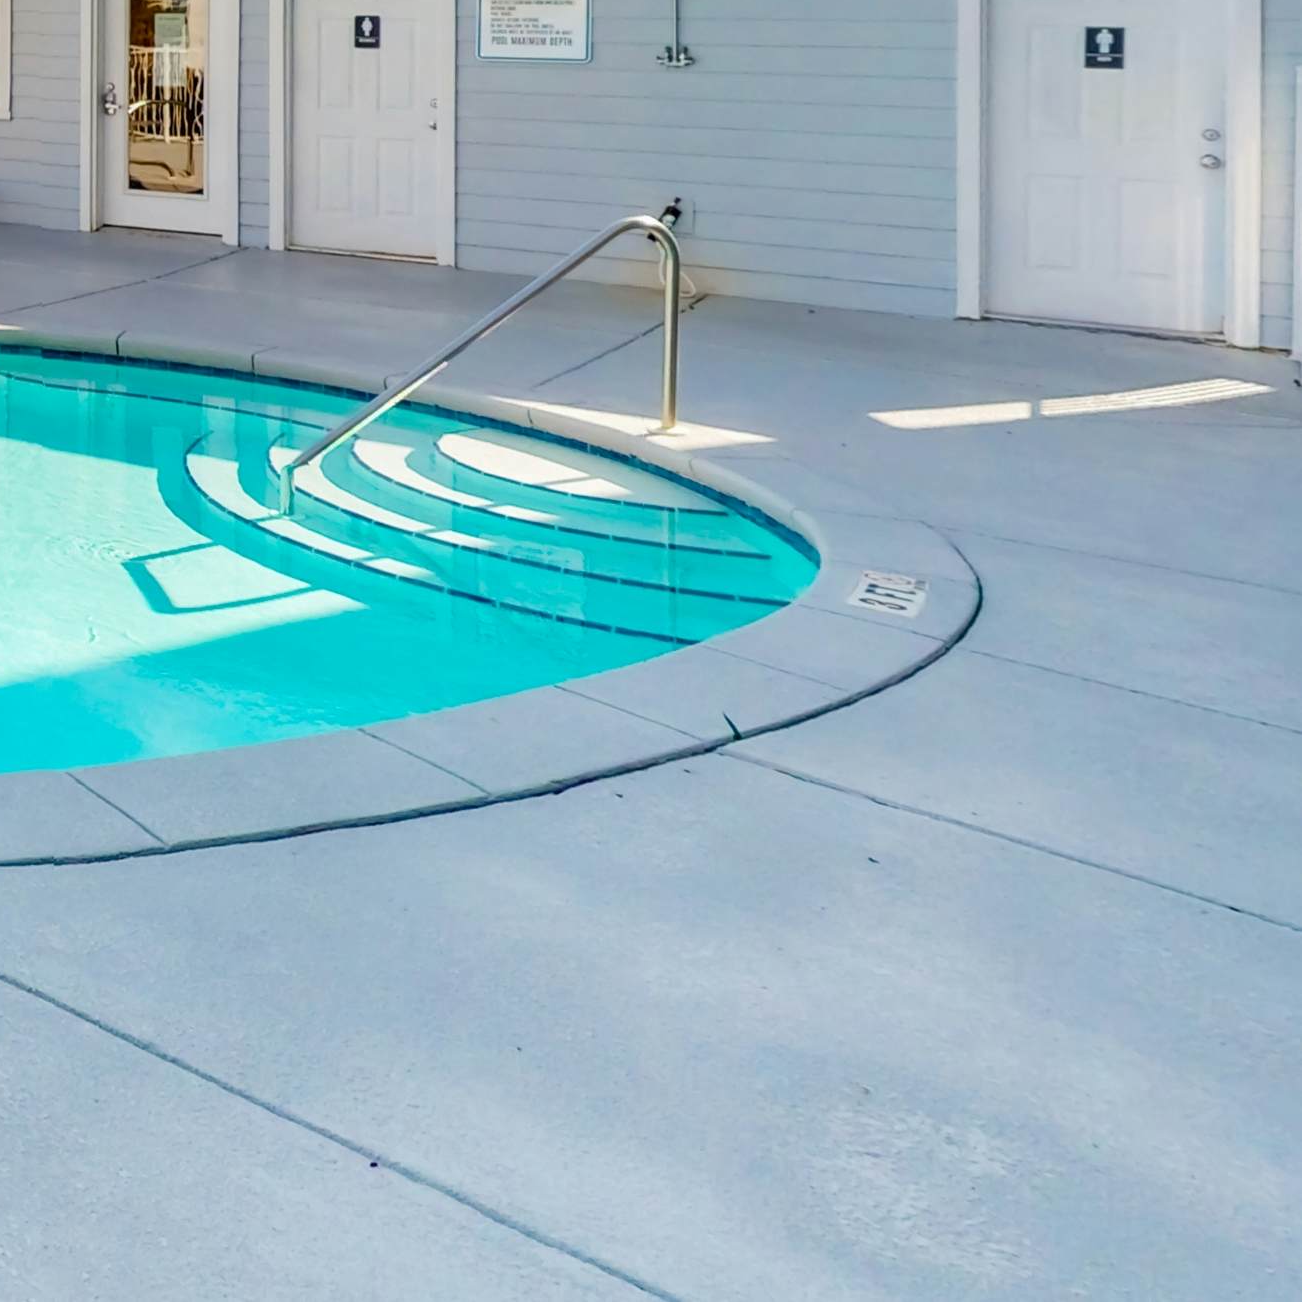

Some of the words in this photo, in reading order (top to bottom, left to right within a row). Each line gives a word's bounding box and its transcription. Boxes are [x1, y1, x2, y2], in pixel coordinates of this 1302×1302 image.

[491, 36, 508, 46] POOL
[511, 36, 547, 46] MAXIMUM
[549, 36, 573, 47] DEPTH
[864, 583, 917, 603] FT
[857, 597, 908, 611] 3
